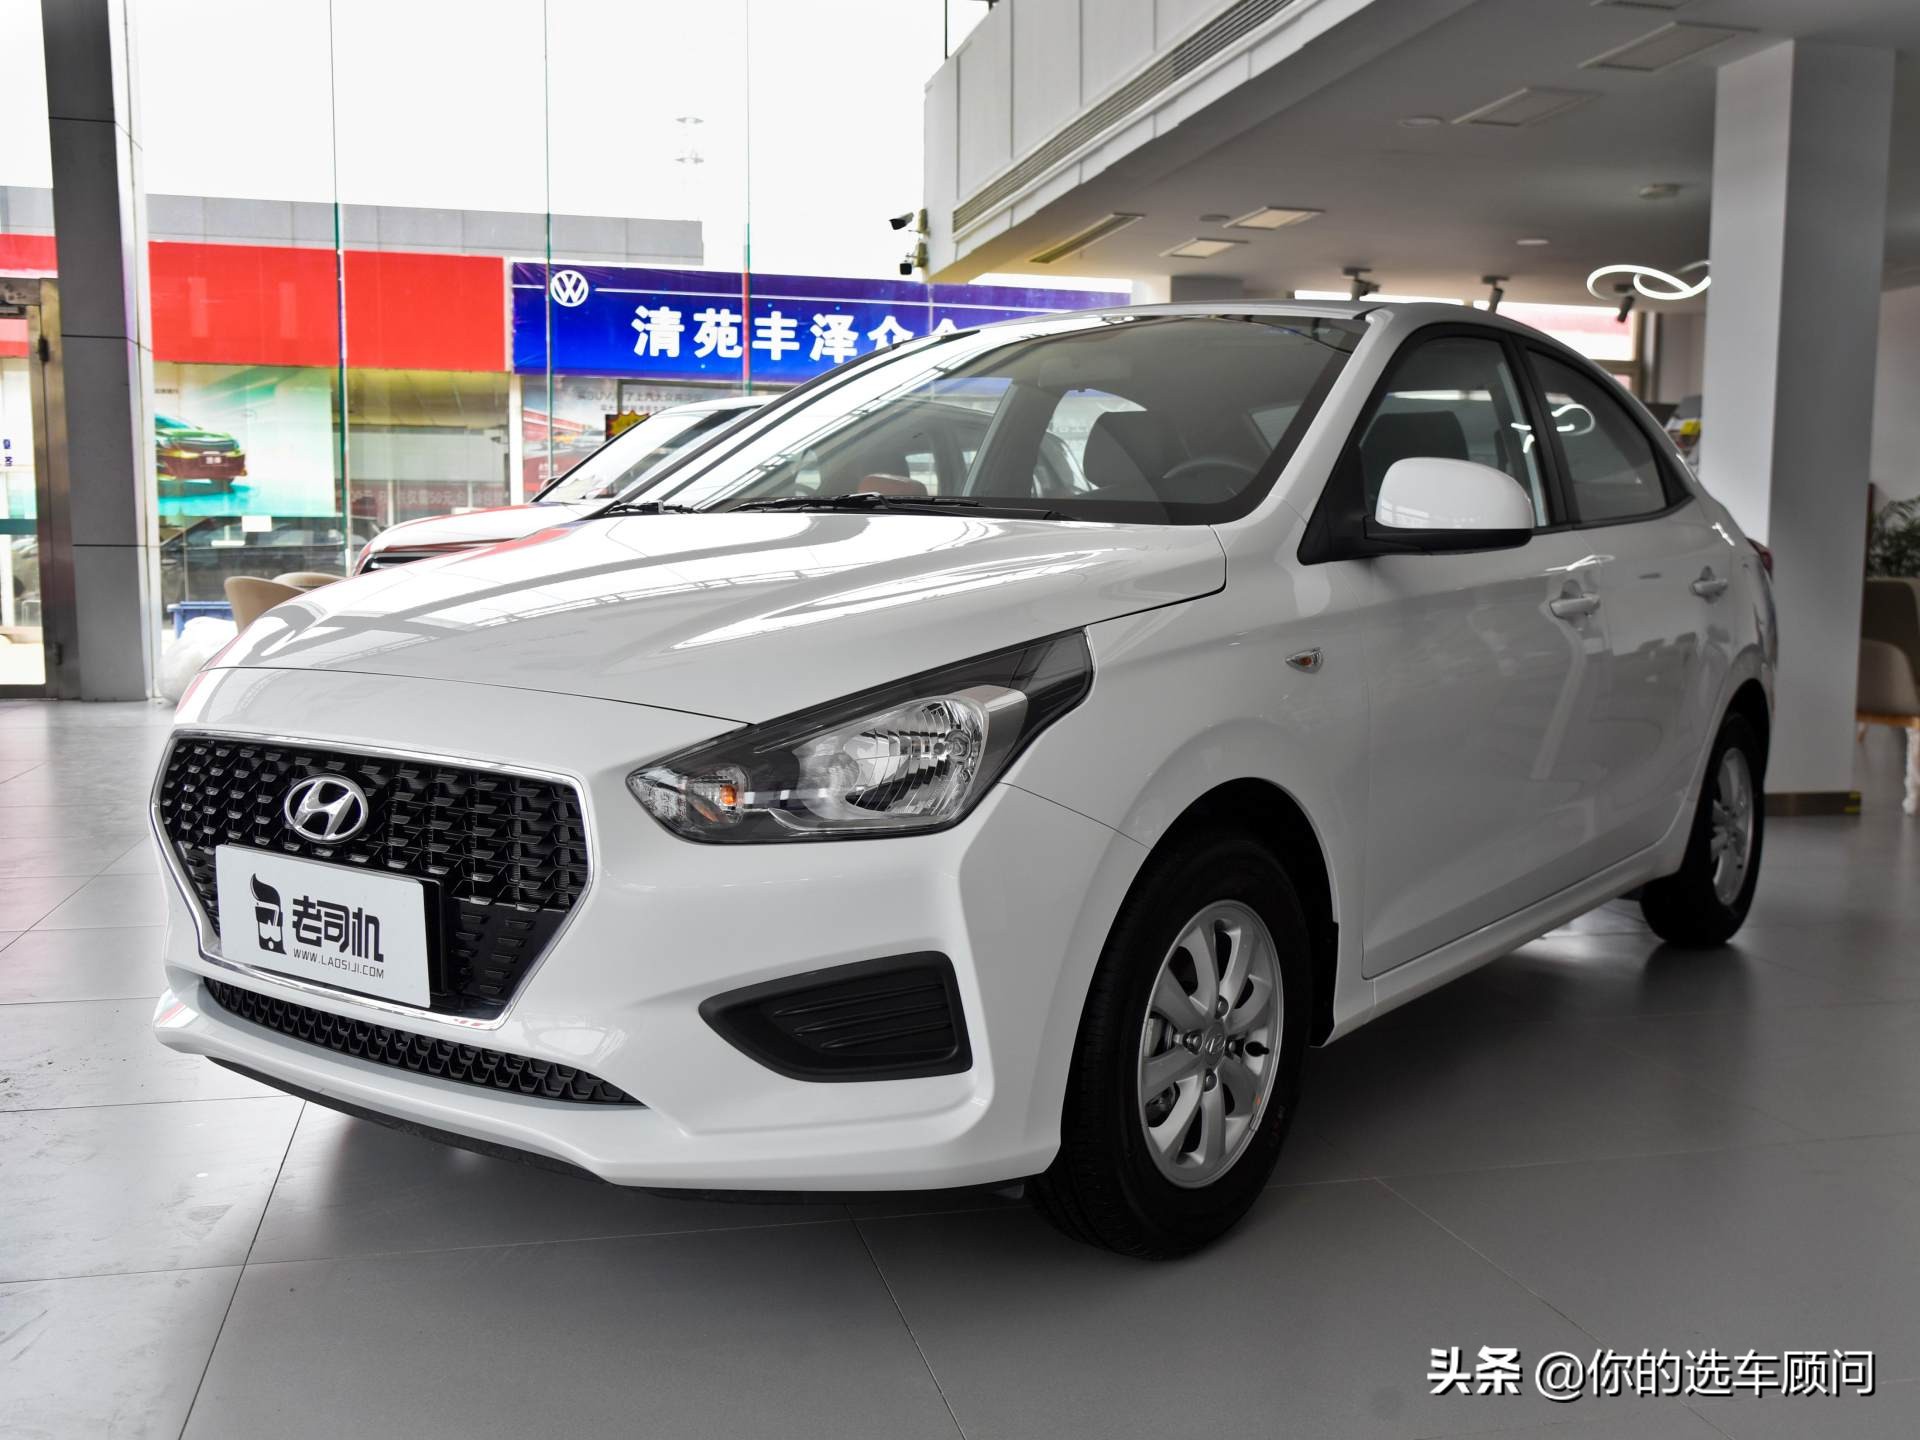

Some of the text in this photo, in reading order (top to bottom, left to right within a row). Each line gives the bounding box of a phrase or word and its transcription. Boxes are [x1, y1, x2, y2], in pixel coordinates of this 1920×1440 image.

[292, 895, 385, 964] 老司机
[293, 948, 385, 979] WWW.LAOSIJI.COM
